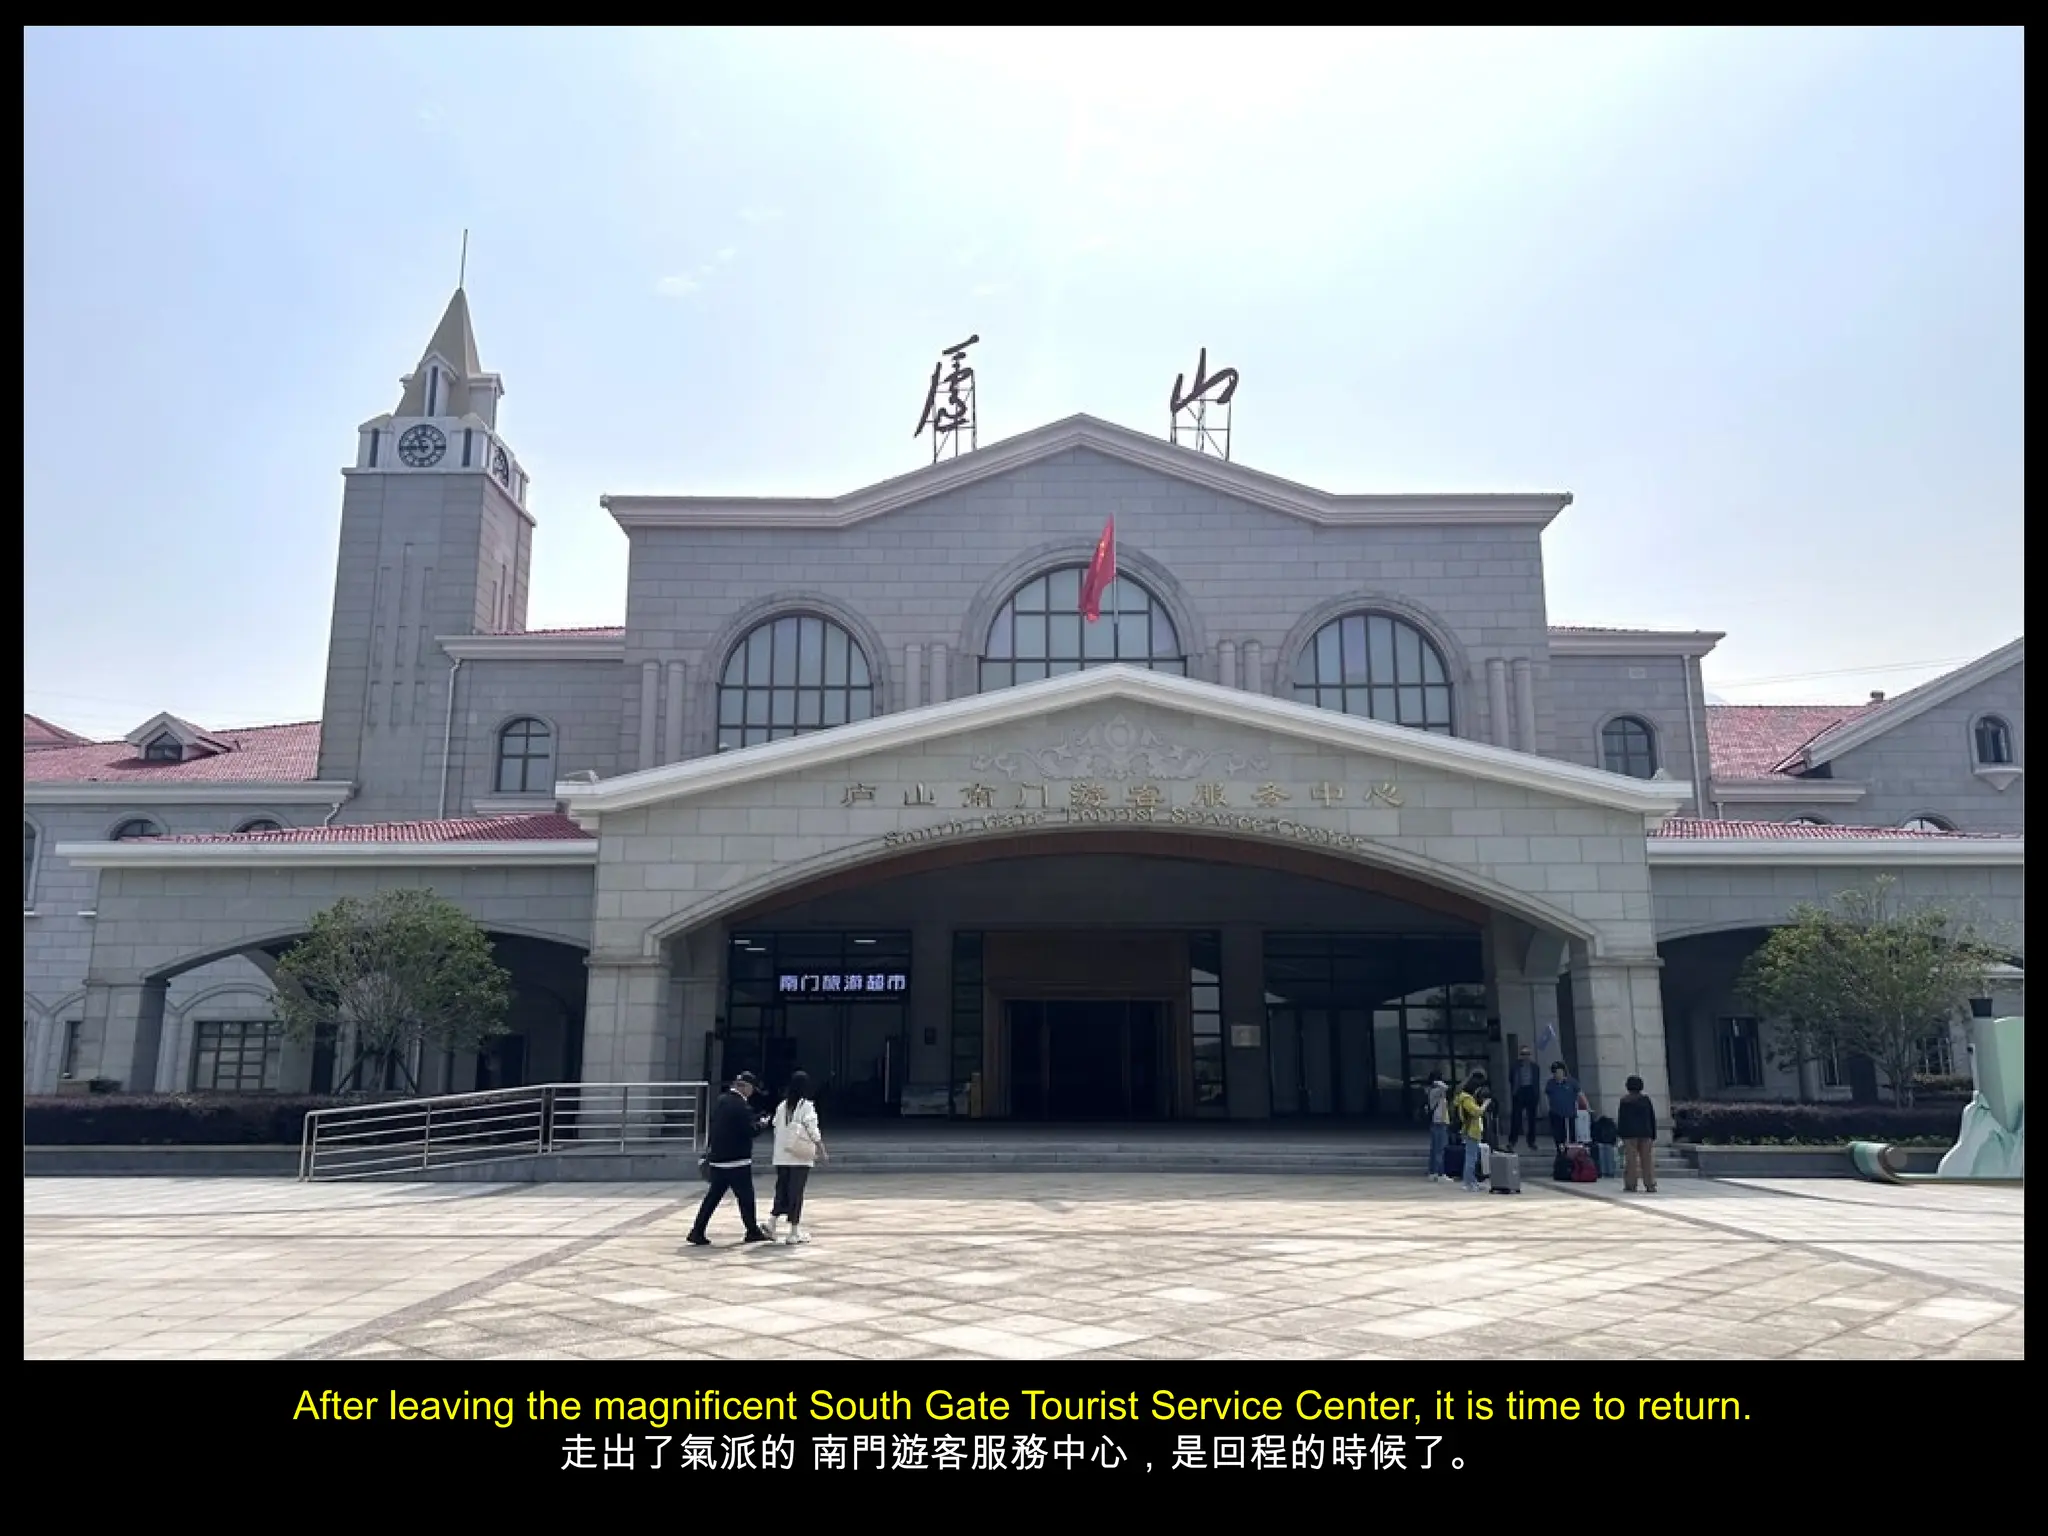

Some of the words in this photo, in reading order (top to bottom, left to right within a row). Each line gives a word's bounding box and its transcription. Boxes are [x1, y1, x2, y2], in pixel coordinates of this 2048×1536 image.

[779, 974, 906, 992] 南门旅游超市
